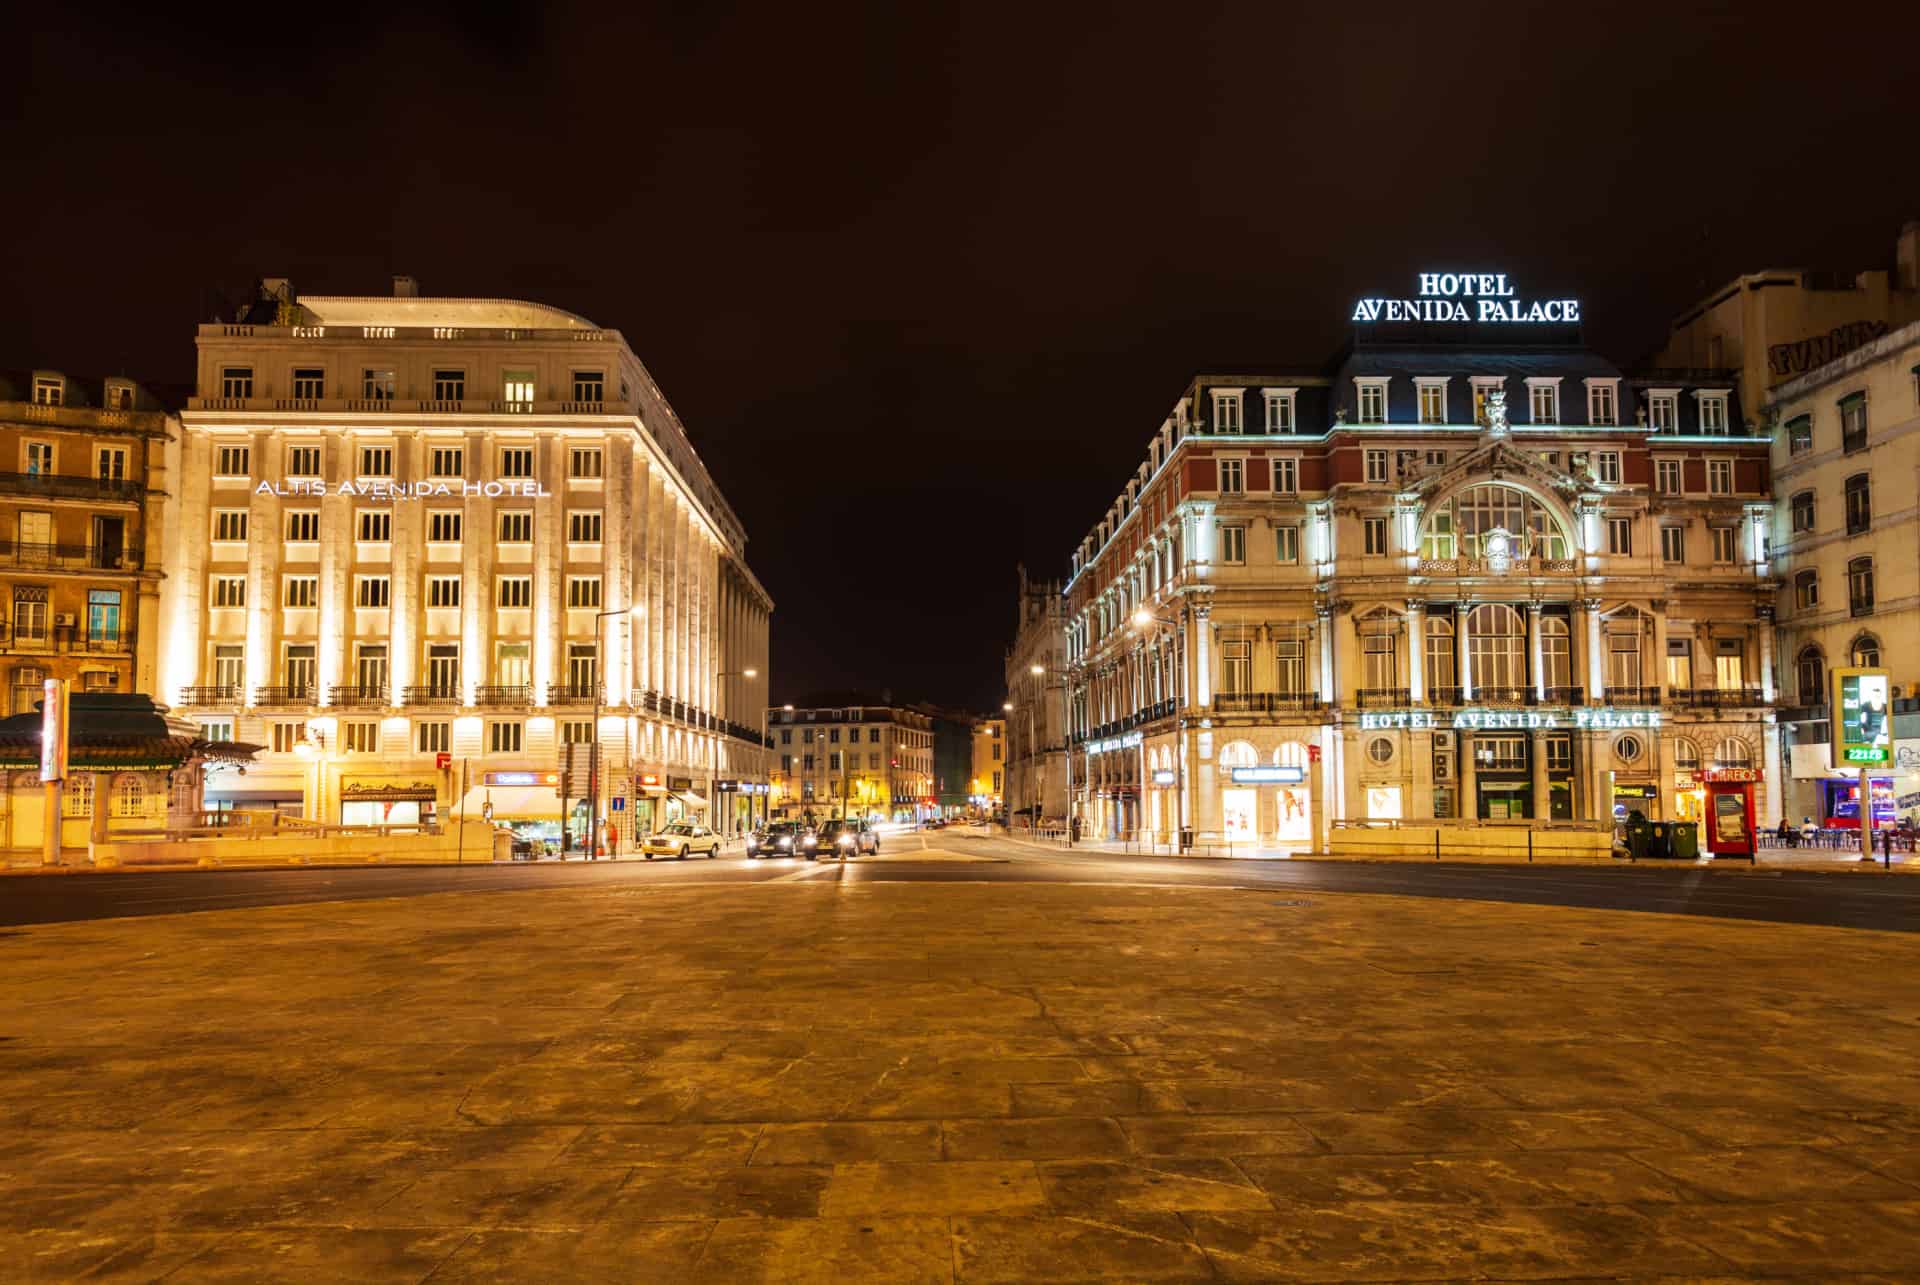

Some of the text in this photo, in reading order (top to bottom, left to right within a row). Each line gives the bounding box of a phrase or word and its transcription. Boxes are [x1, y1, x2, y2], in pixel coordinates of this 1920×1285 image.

[1419, 273, 1514, 296] HOTEL
[1352, 298, 1580, 322] AVENIDA PALACE
[255, 479, 550, 497] ALTIS AVENIDA HOTEL
[1361, 710, 1662, 729] HOTEL AVENIDA PALACE
